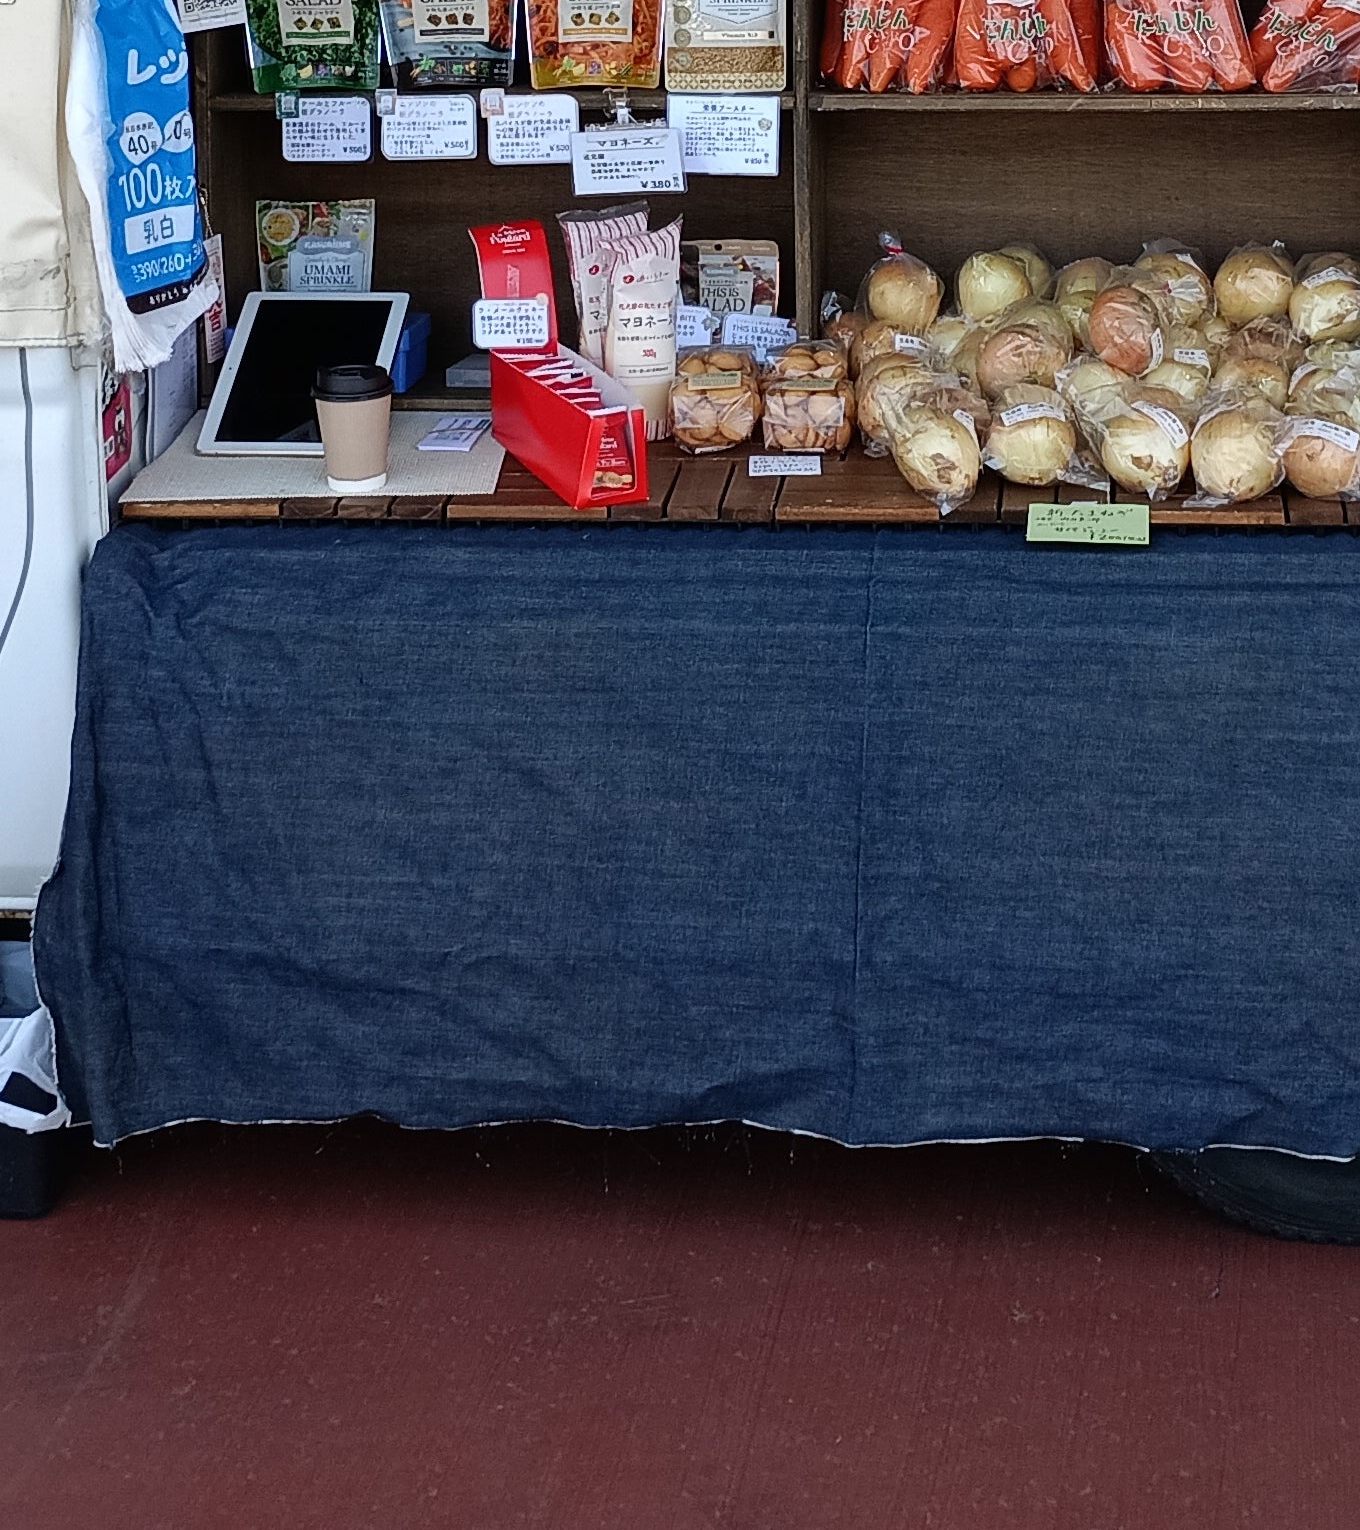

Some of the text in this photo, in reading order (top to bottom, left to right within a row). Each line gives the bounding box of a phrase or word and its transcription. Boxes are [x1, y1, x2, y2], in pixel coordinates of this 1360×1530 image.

[143, 214, 175, 245] 乳白
[304, 264, 351, 276] UMAMI
[299, 274, 354, 285] SPRINKLE
